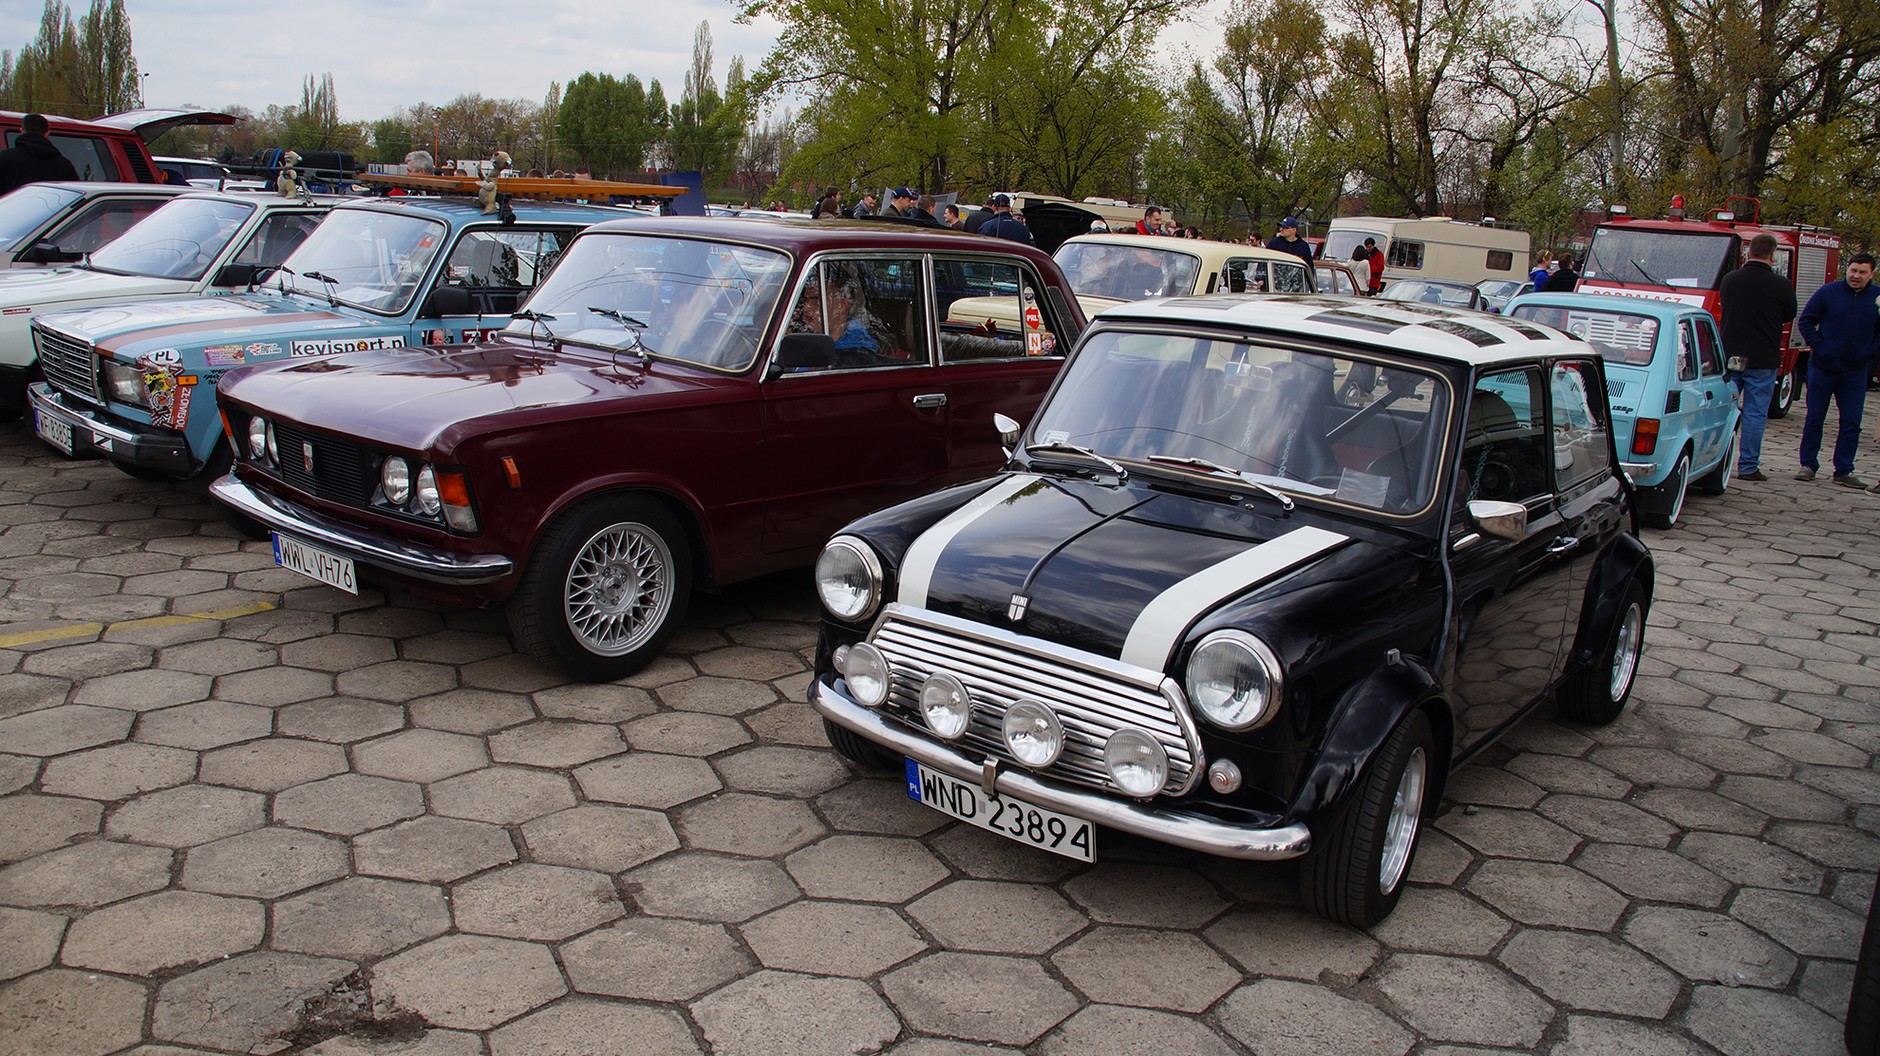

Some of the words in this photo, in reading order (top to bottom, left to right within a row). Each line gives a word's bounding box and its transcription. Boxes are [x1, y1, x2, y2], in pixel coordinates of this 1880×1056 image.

[155, 351, 174, 361] PL
[281, 540, 312, 574] WWL
[314, 552, 352, 588] VH76
[1011, 594, 1028, 607] MINI
[910, 783, 919, 794] PL
[921, 768, 976, 818] WND
[988, 798, 1090, 858] 23894
